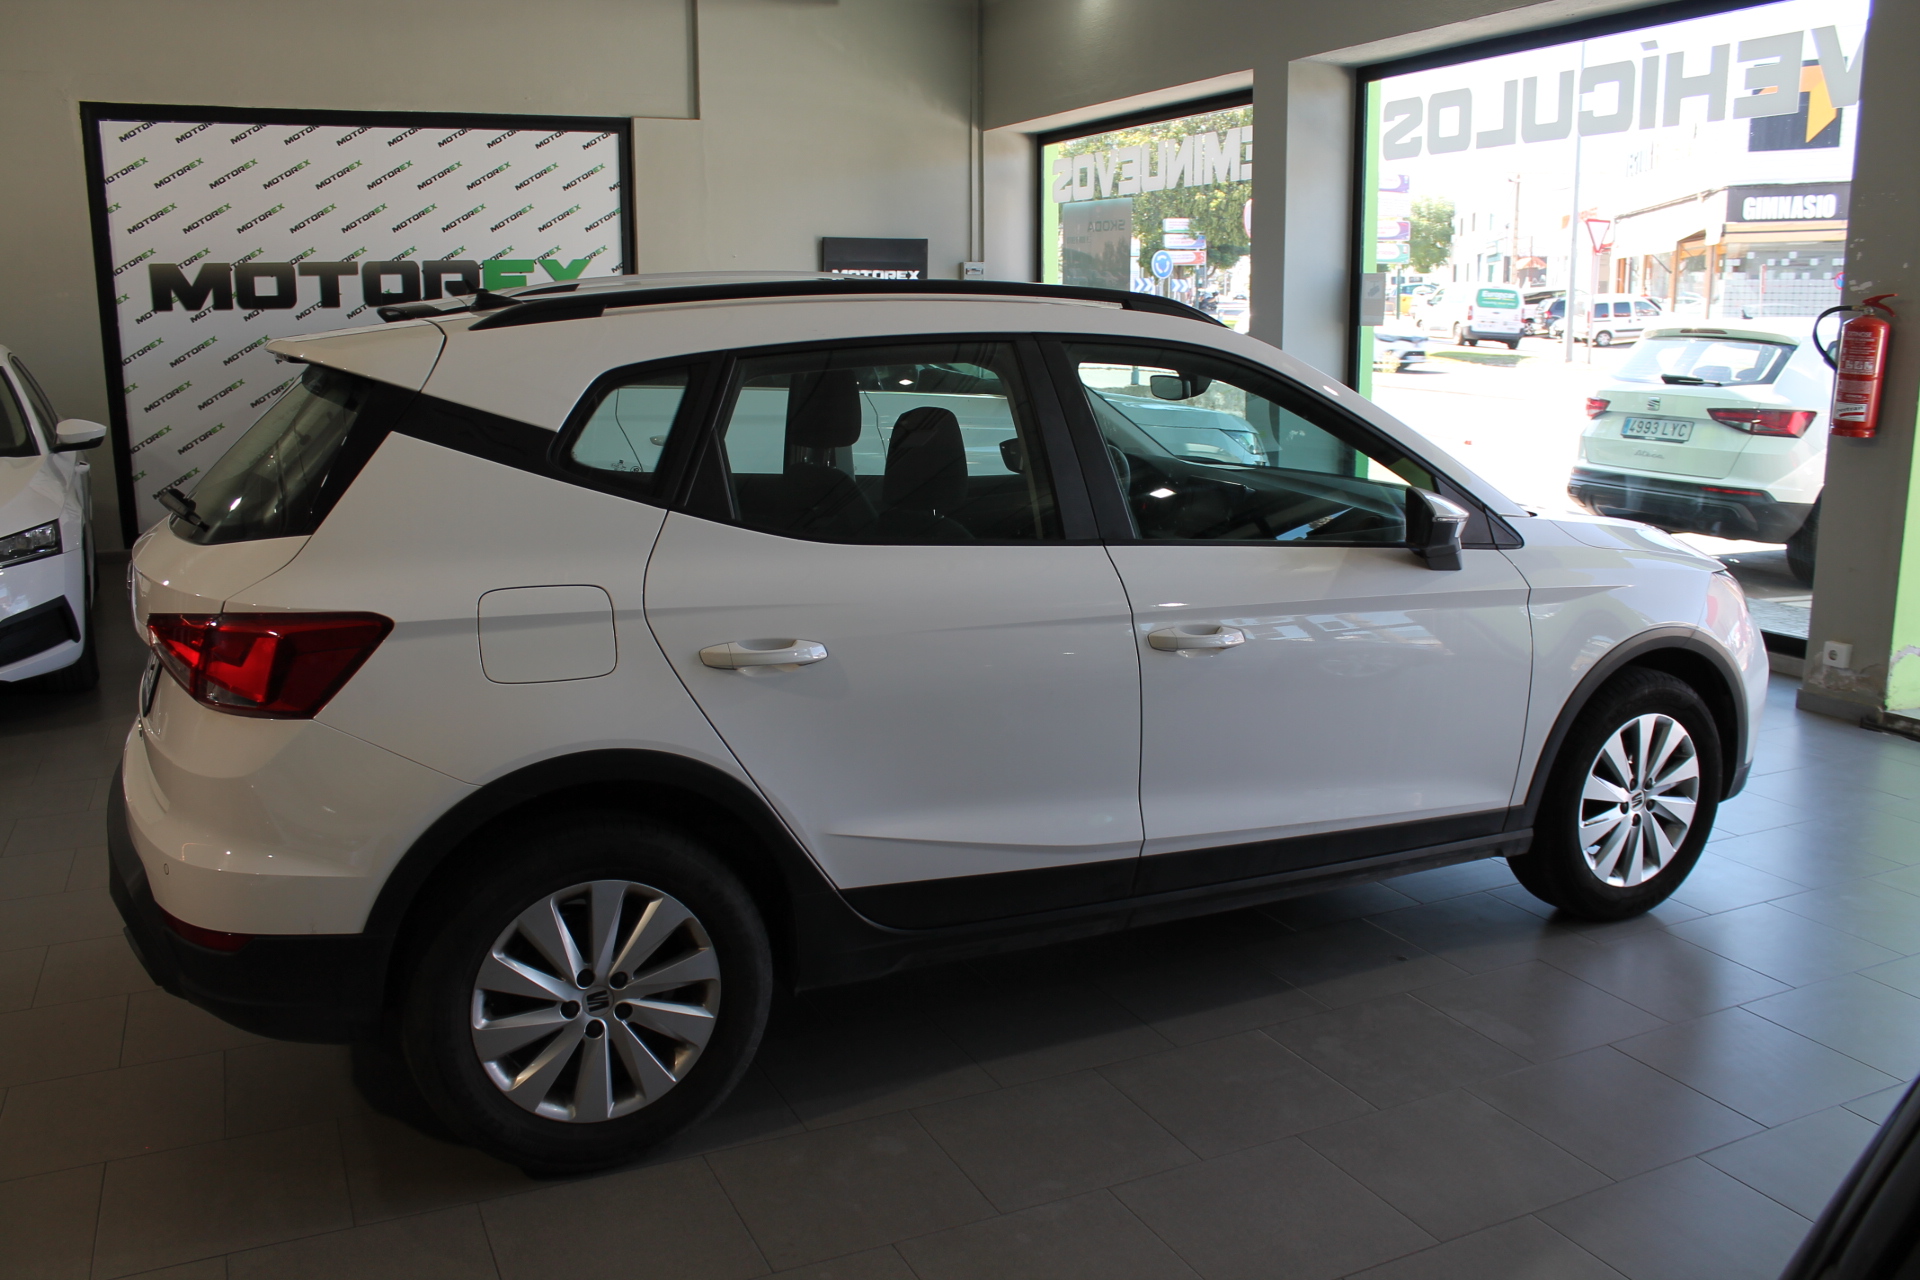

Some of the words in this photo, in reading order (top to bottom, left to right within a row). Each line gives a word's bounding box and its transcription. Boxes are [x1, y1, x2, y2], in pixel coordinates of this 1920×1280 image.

[154, 158, 204, 189] MOTOREX
[209, 159, 258, 190] MOTOREX
[263, 159, 312, 190] MOTOREX
[315, 159, 363, 190] MOTOREX
[366, 160, 414, 191] MOTOREX
[417, 161, 463, 191] MOTOREX
[466, 161, 512, 191] MOTOREX
[514, 162, 559, 192] MOTOREX
[562, 163, 606, 192] MOTOREX
[127, 203, 178, 235] MOTOREX
[182, 203, 233, 235] MOTOREX
[237, 203, 286, 234] MOTOREX
[290, 203, 338, 234] MOTOREX
[341, 203, 388, 234] MOTOREX
[392, 203, 438, 233] MOTOREX
[441, 203, 487, 233] MOTOREX
[490, 203, 535, 233] MOTOREX
[537, 204, 582, 233] MOTOREX
[584, 206, 622, 233] MOTORE
[1742, 193, 1837, 221] GIMNASIO
[178, 247, 212, 270] TOREX
[288, 246, 317, 266] OREX
[169, 335, 218, 368] MOTOREX
[223, 334, 271, 366] MOTOREX
[144, 380, 193, 413] MOTOREX
[198, 379, 246, 411] MOTOREX
[178, 422, 226, 456] MOTOREX
[1629, 420, 1660, 435] 4993
[1661, 422, 1687, 438] LYC
